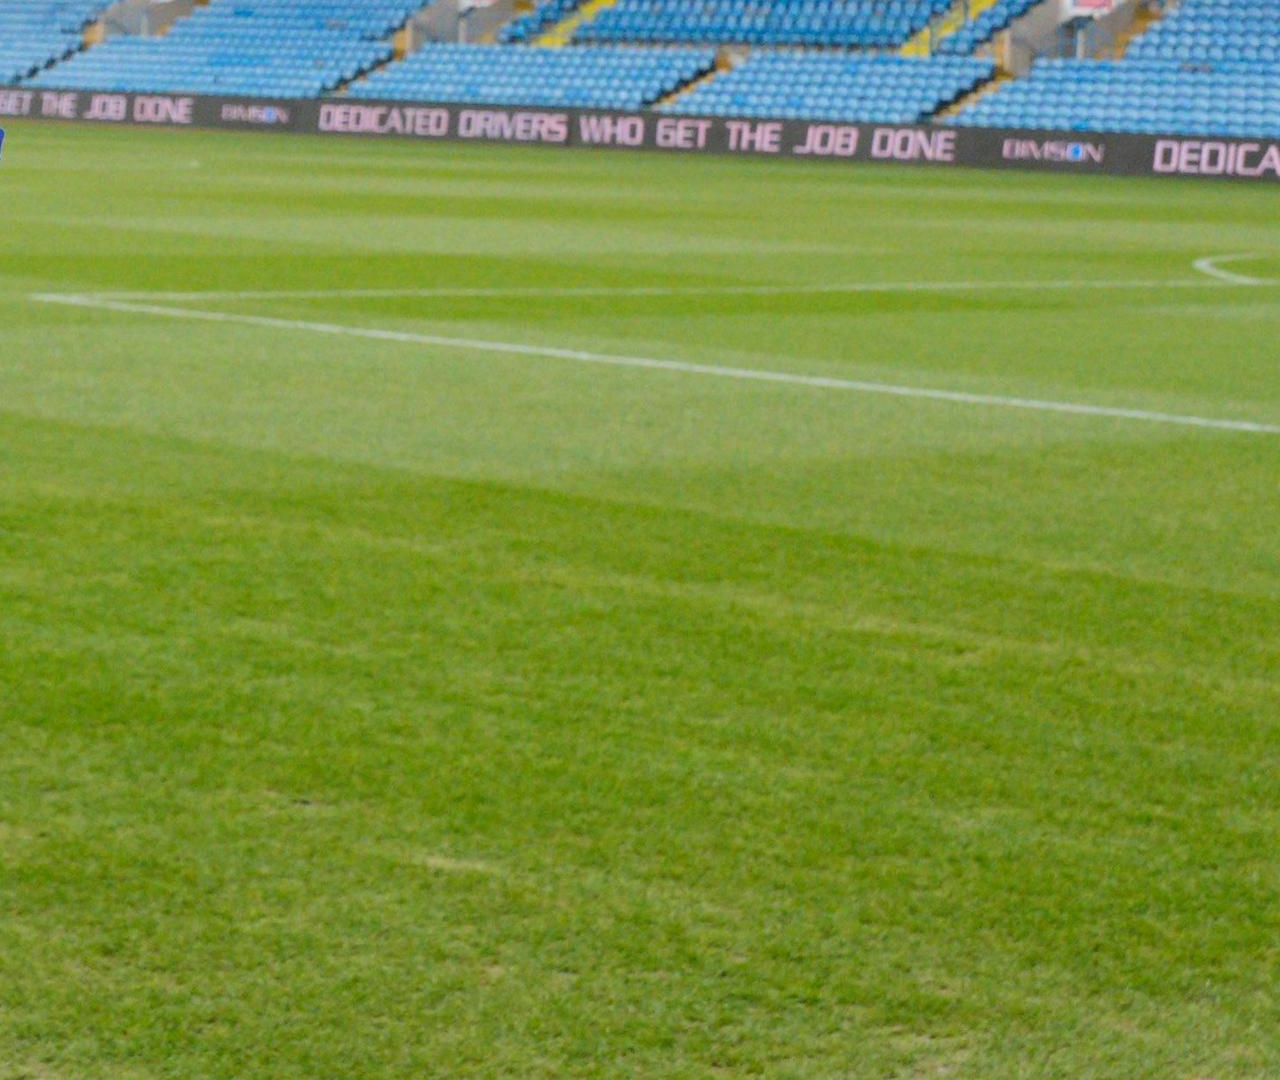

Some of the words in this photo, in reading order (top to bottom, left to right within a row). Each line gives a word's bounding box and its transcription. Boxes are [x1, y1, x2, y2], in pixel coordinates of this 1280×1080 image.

[41, 91, 77, 118] THE
[83, 94, 126, 120] JOB
[133, 96, 193, 123] DONE
[320, 104, 449, 136] DEDICATED
[459, 109, 568, 142] DRIVERS
[580, 114, 644, 147] WHO
[656, 118, 712, 149] GET
[726, 122, 783, 153] THE
[793, 125, 859, 156] JOB
[871, 128, 957, 161] DONE
